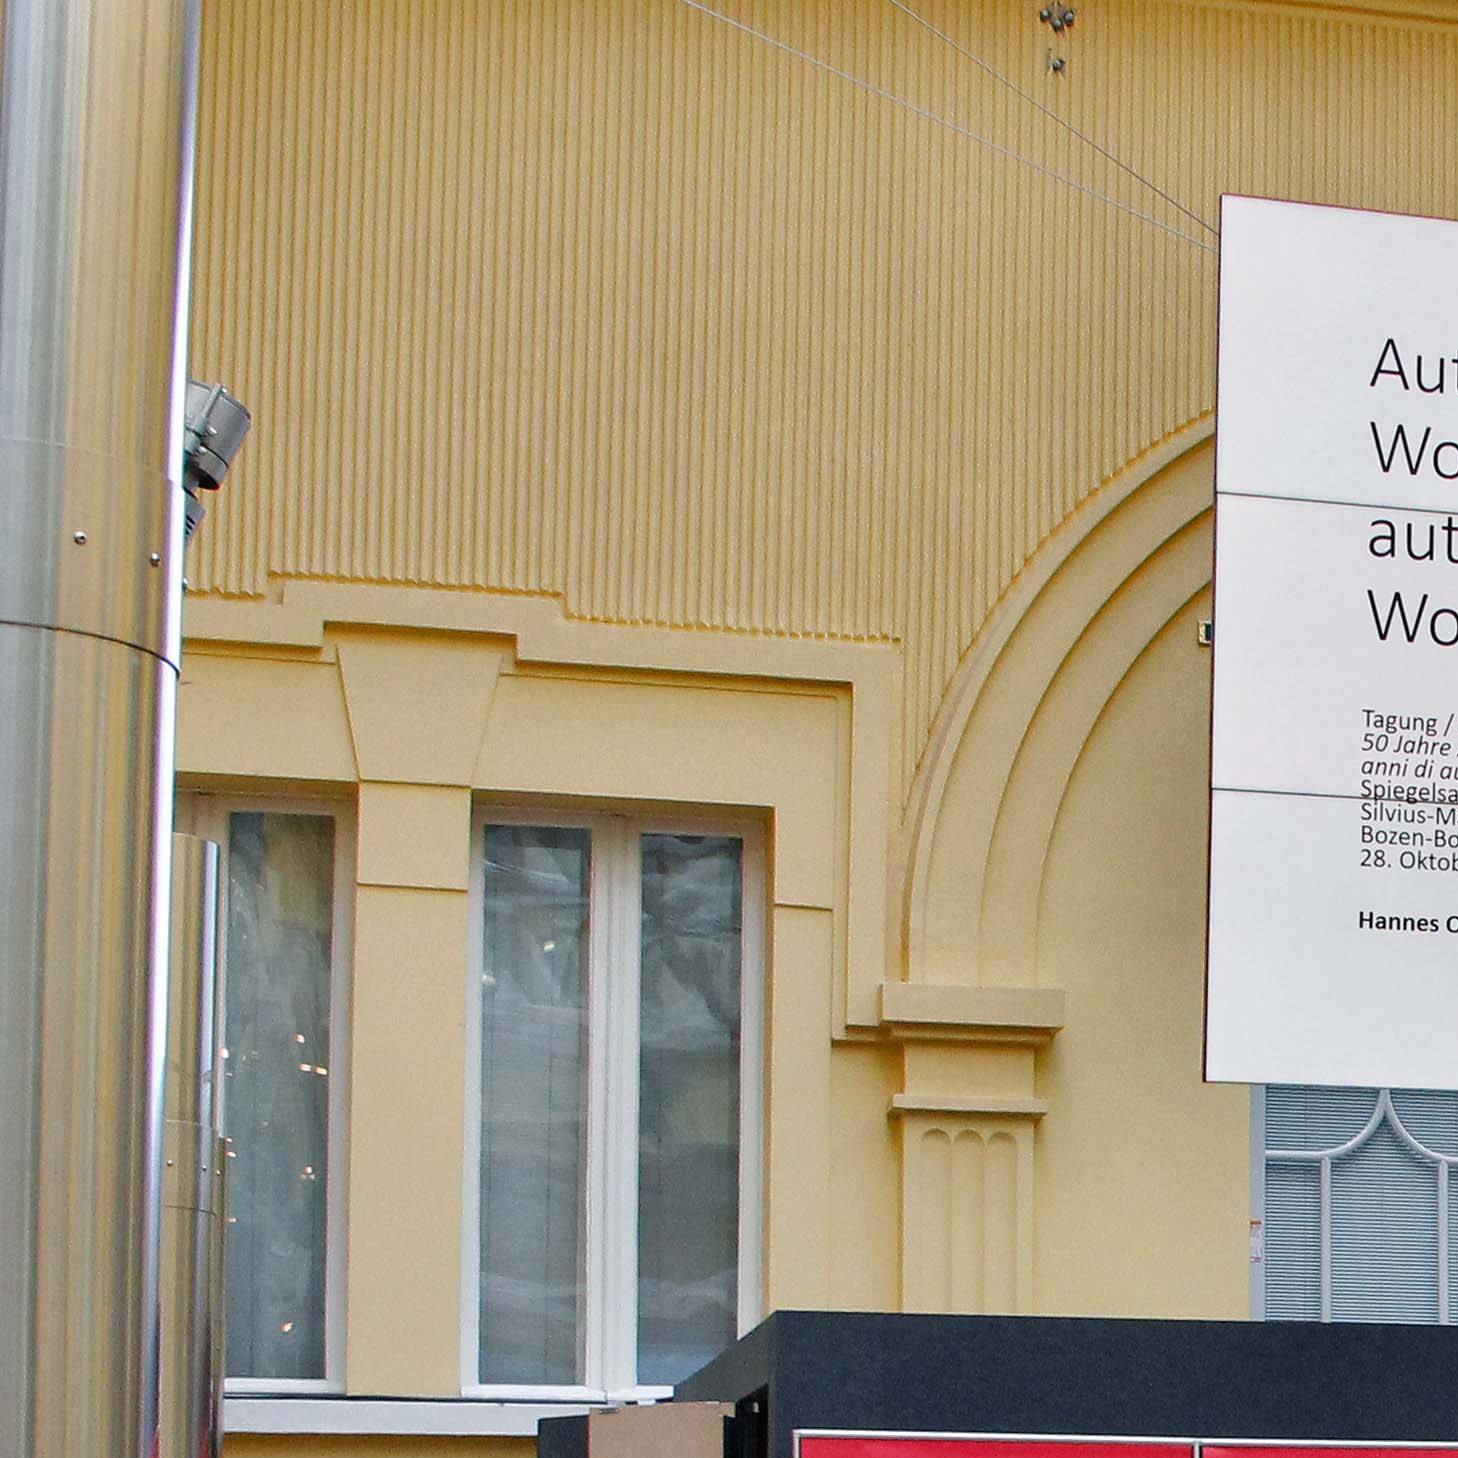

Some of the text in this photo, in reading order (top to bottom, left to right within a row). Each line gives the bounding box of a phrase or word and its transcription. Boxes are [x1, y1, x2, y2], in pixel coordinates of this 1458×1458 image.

[1362, 709, 1438, 737] Tagung
[1443, 713, 1455, 737] /
[1361, 733, 1389, 752] 50
[1393, 735, 1452, 757] Jahre
[1361, 758, 1409, 777] anni
[1414, 759, 1434, 778] di
[1360, 849, 1392, 869] 28.
[1359, 911, 1439, 933] Hannes
